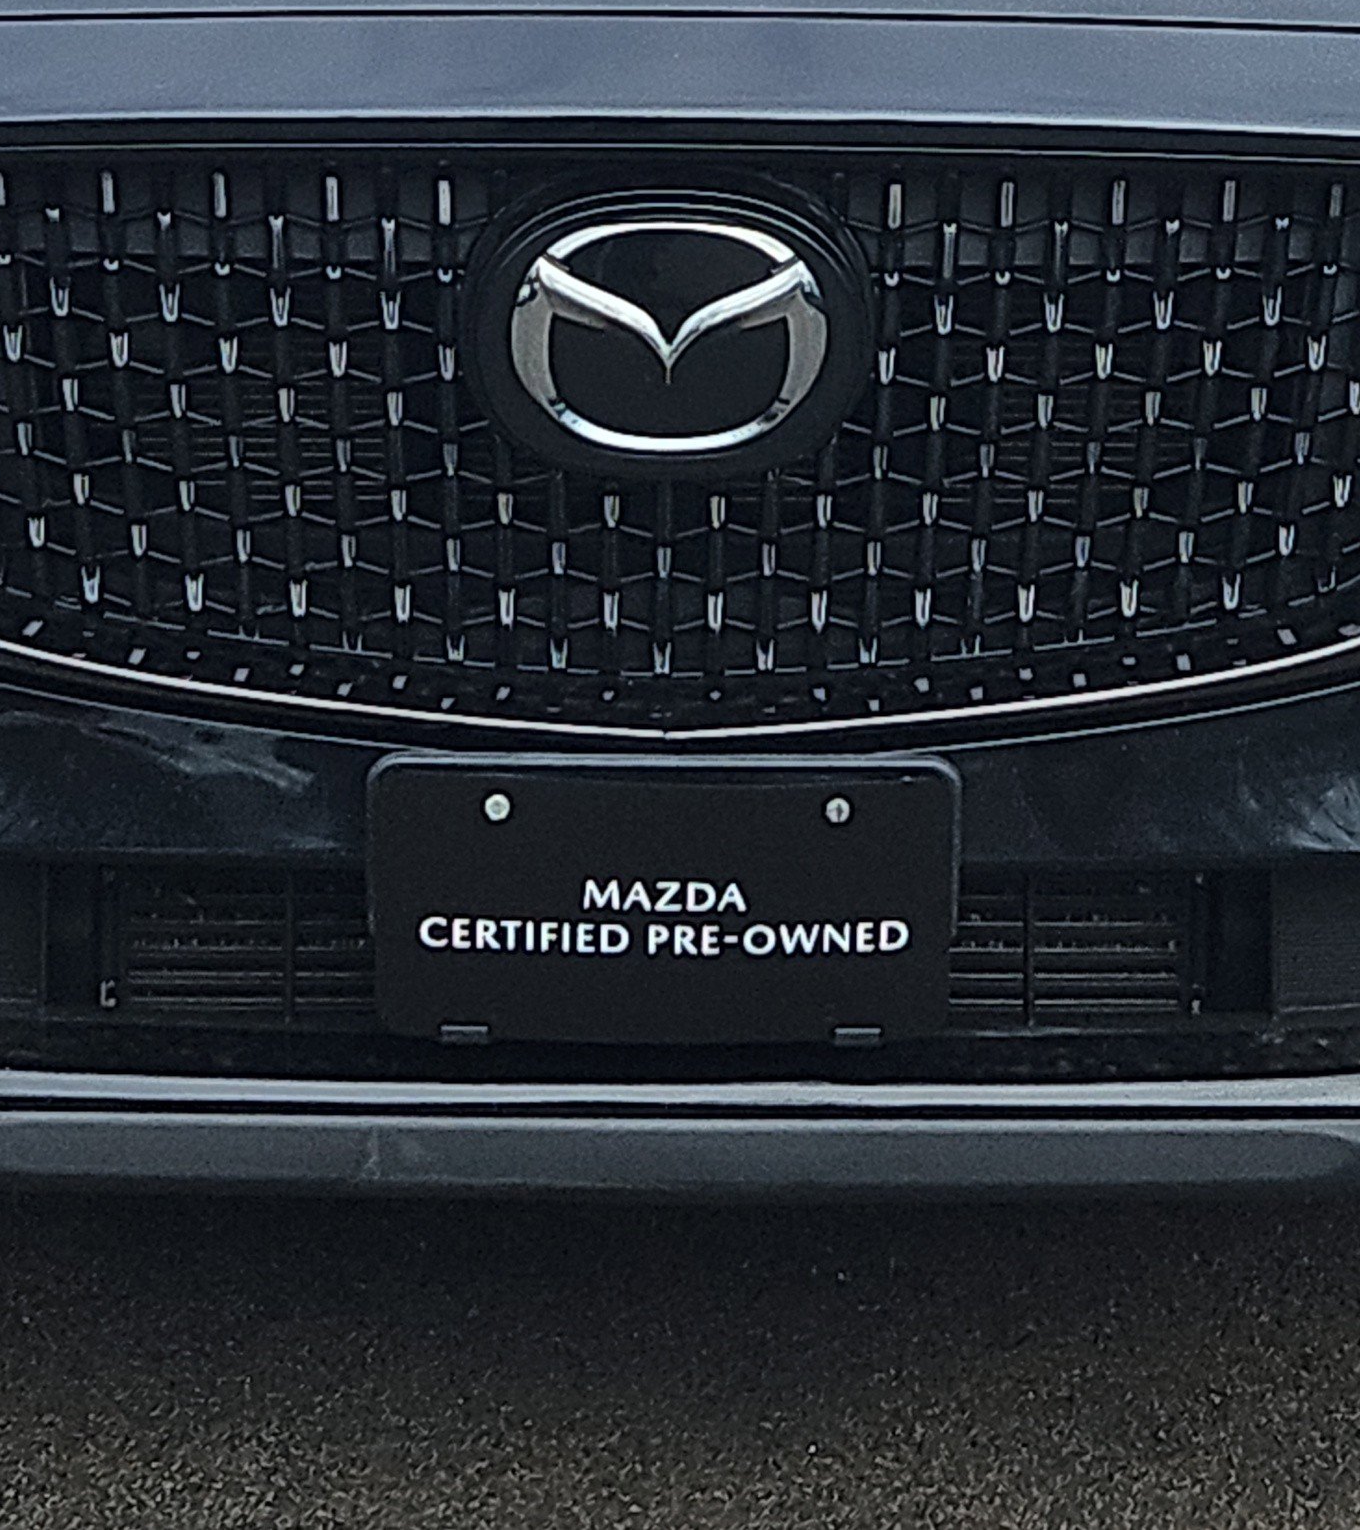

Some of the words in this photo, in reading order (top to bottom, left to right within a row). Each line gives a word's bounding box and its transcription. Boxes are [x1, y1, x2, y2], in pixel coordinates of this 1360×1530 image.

[583, 880, 747, 912] MAZDA
[418, 916, 630, 954] CERTIFIED
[648, 920, 909, 956] PRE-OWNED
